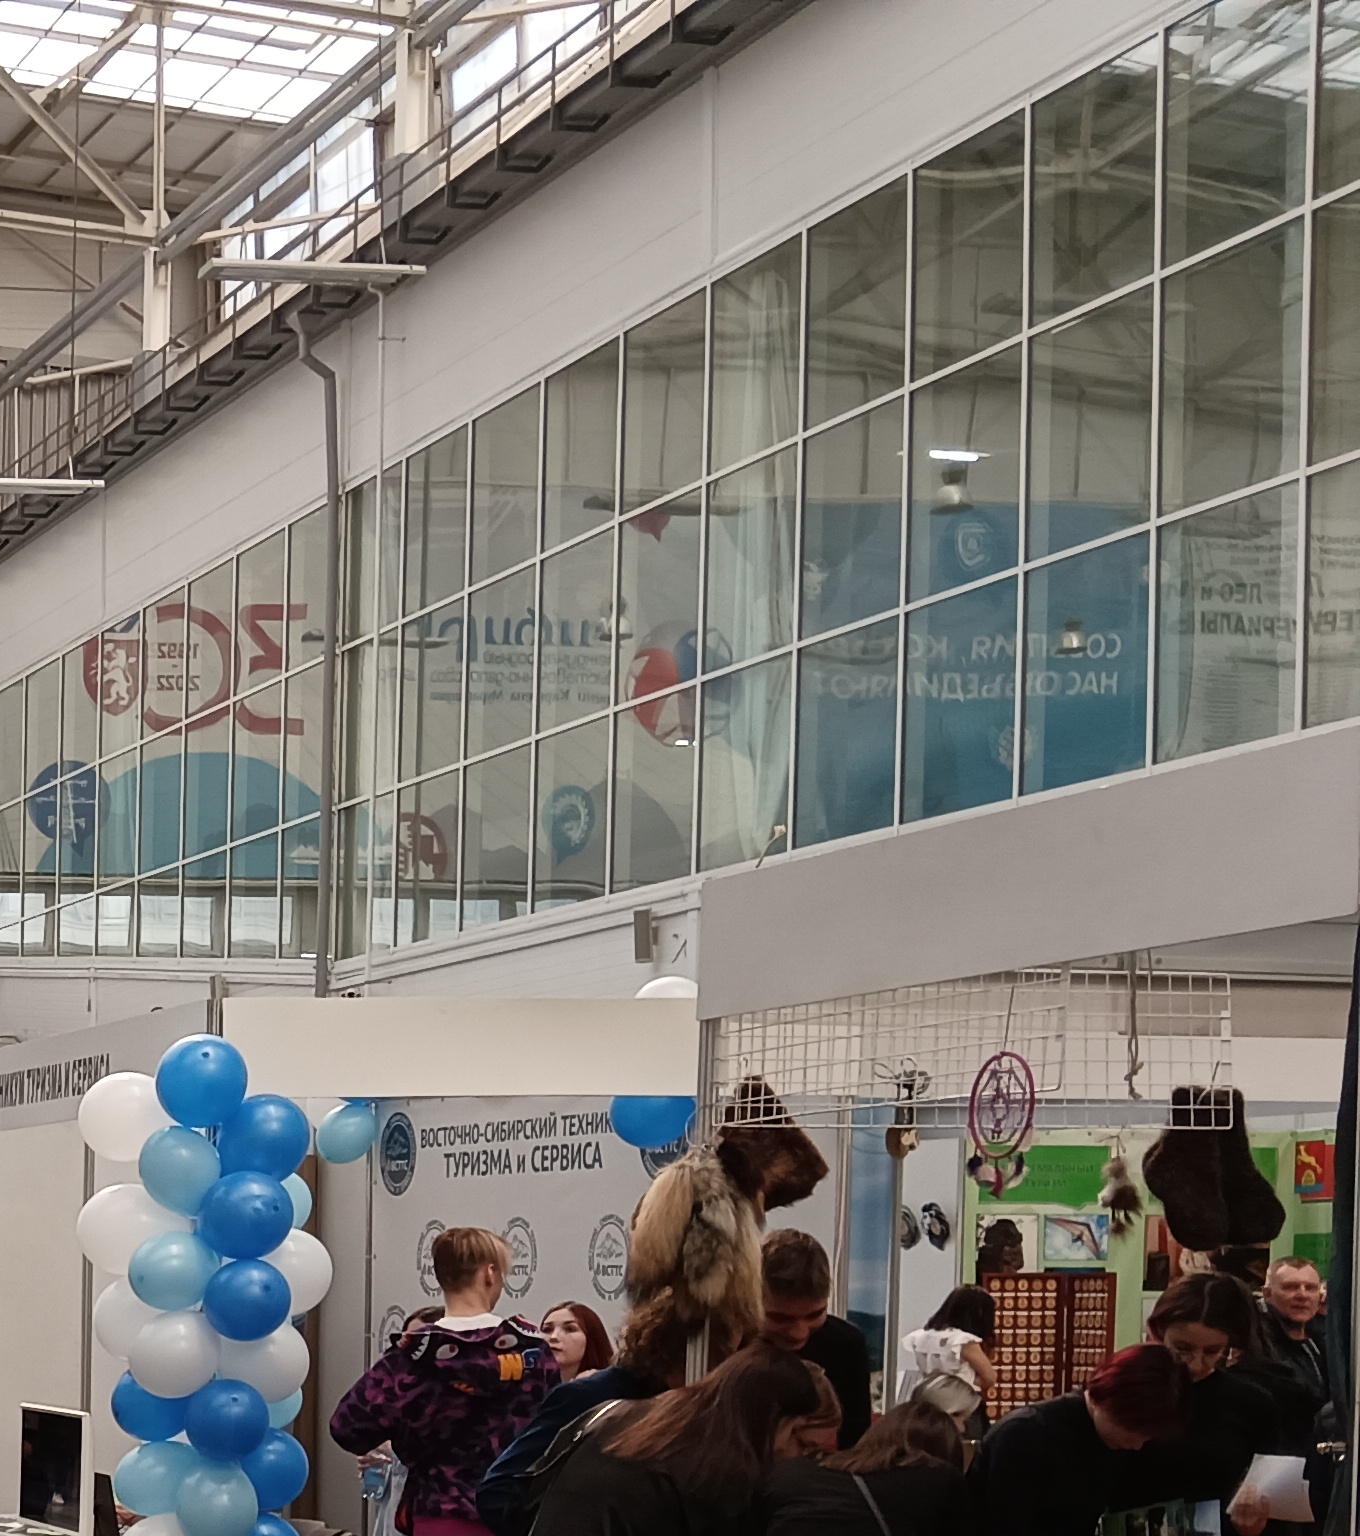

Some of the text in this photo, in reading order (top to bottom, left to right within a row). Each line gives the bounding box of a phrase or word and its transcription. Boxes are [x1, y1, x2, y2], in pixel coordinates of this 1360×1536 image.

[420, 1111, 558, 1149] ВОСТОЧНО-СИБИРСКИЙ
[443, 1141, 603, 1179] ТУРИЗМА и СЕРВИСА
